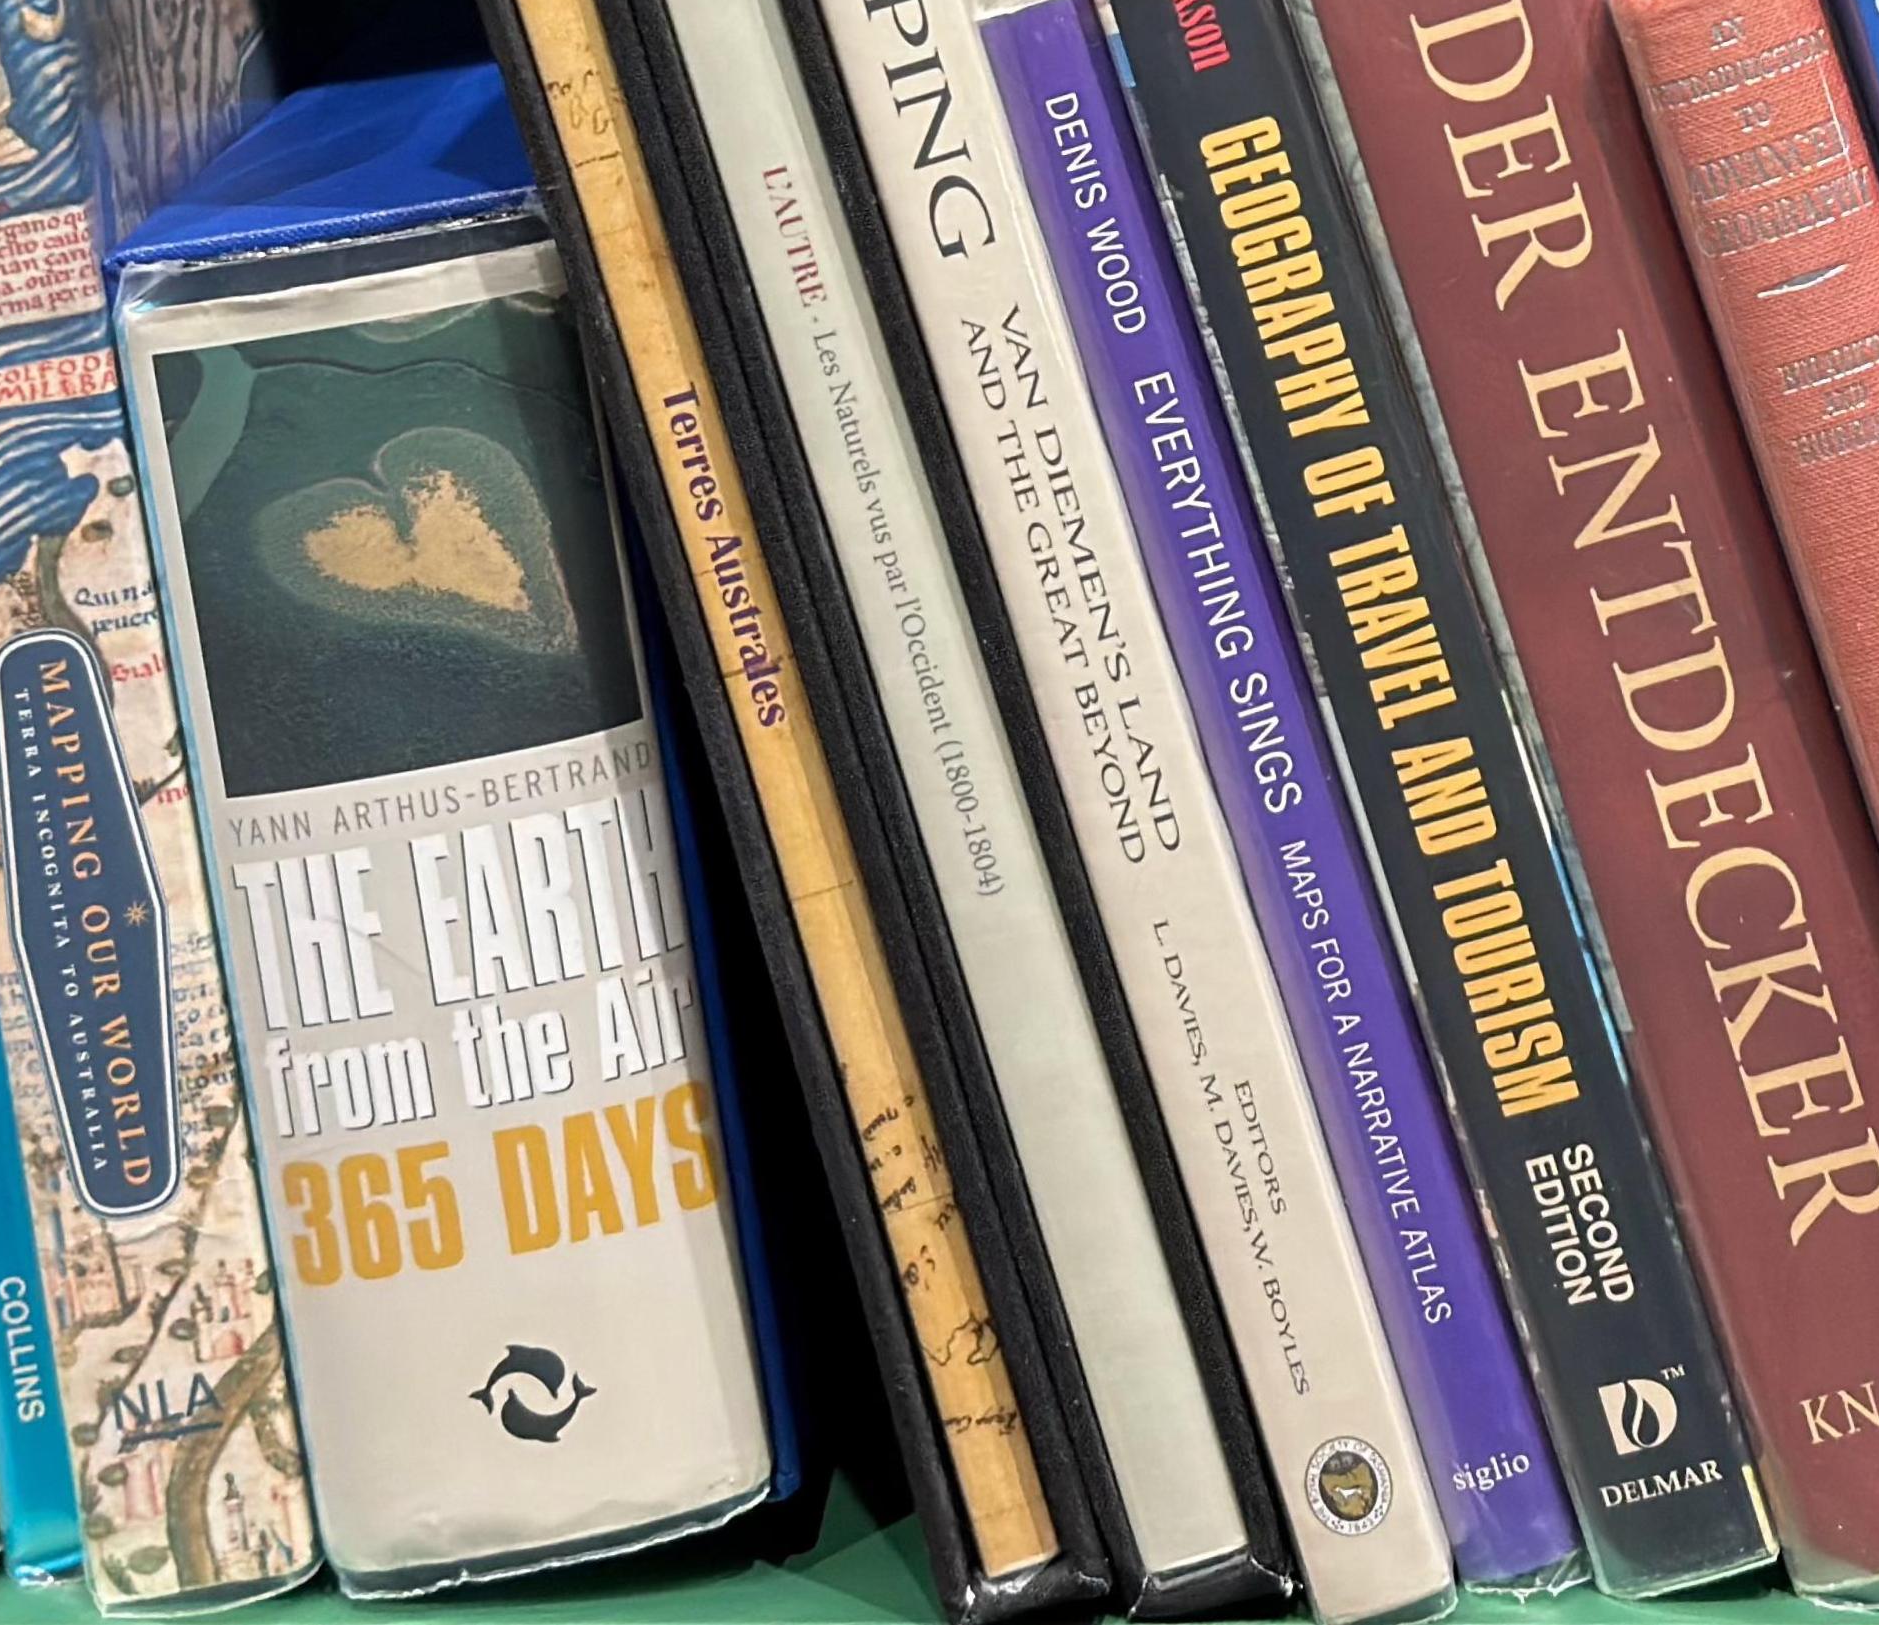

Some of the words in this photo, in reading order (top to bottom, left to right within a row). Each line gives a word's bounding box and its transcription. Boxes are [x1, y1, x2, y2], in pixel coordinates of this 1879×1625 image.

[763, 165, 827, 308] L'AUTRE
[1199, 115, 1370, 438] GEOGRAPHY
[812, 329, 840, 376] Les
[829, 382, 880, 495] Naturels
[1045, 92, 1107, 207] DENIS
[1085, 220, 1146, 334] WOOD
[1135, 372, 1254, 659] EVERYTHING
[1230, 671, 1303, 814] SINGS
[1303, 446, 1395, 517] OF
[662, 382, 724, 522] Terres
[705, 534, 785, 727] Australes
[869, 500, 891, 544] vus
[874, 551, 907, 600] par
[962, 318, 1007, 410] AND
[997, 421, 1041, 512] THE
[1027, 522, 1090, 670] GREAT
[1074, 682, 1147, 864] BEYOND
[1001, 302, 1046, 409] VAN
[1035, 425, 1129, 680] DIEMEN'S
[1119, 700, 1180, 852] LAND
[895, 595, 949, 734] l'Occident
[1328, 524, 1458, 730] TRAVEL
[15, 688, 41, 777] TERRA
[229, 812, 312, 846] YANN
[332, 740, 653, 832] ARTHUS-BERTRAND
[1391, 736, 1498, 855] AND
[31, 794, 71, 949] INCOGNITA
[940, 738, 1005, 896] (1800-1804)
[1280, 840, 1329, 930] MAPS
[40, 659, 102, 880] MAPPING
[81, 904, 119, 999] OUR
[100, 1015, 151, 1186] WORLD
[63, 965, 79, 997] TO
[232, 848, 394, 1030] THE
[409, 790, 685, 1007] EARTH
[1310, 938, 1353, 1002] FOR
[266, 1037, 437, 1137] from
[452, 1009, 573, 1108] the
[596, 967, 696, 1084] Air
[1332, 1014, 1362, 1035] A
[1432, 858, 1580, 1118] TOURISM
[69, 1012, 107, 1171] AUSTRALIA
[1153, 918, 1166, 947] L.
[1164, 954, 1207, 1066] DAVIES,
[1199, 1075, 1219, 1115] M.
[1263, 1280, 1311, 1396] BOYLES
[1234, 1078, 1288, 1215] EDITORS
[1343, 1043, 1421, 1220] NARRATIVE
[283, 1140, 465, 1285] 365
[493, 1080, 719, 1255] DAYS
[1525, 1156, 1597, 1307] EDITION
[1562, 1144, 1635, 1302] SECOND
[1400, 1226, 1452, 1324] ATLAS
[116, 1374, 222, 1432] NLA
[1453, 1453, 1530, 1492] siglio
[1600, 1459, 1723, 1508] DELMAR
